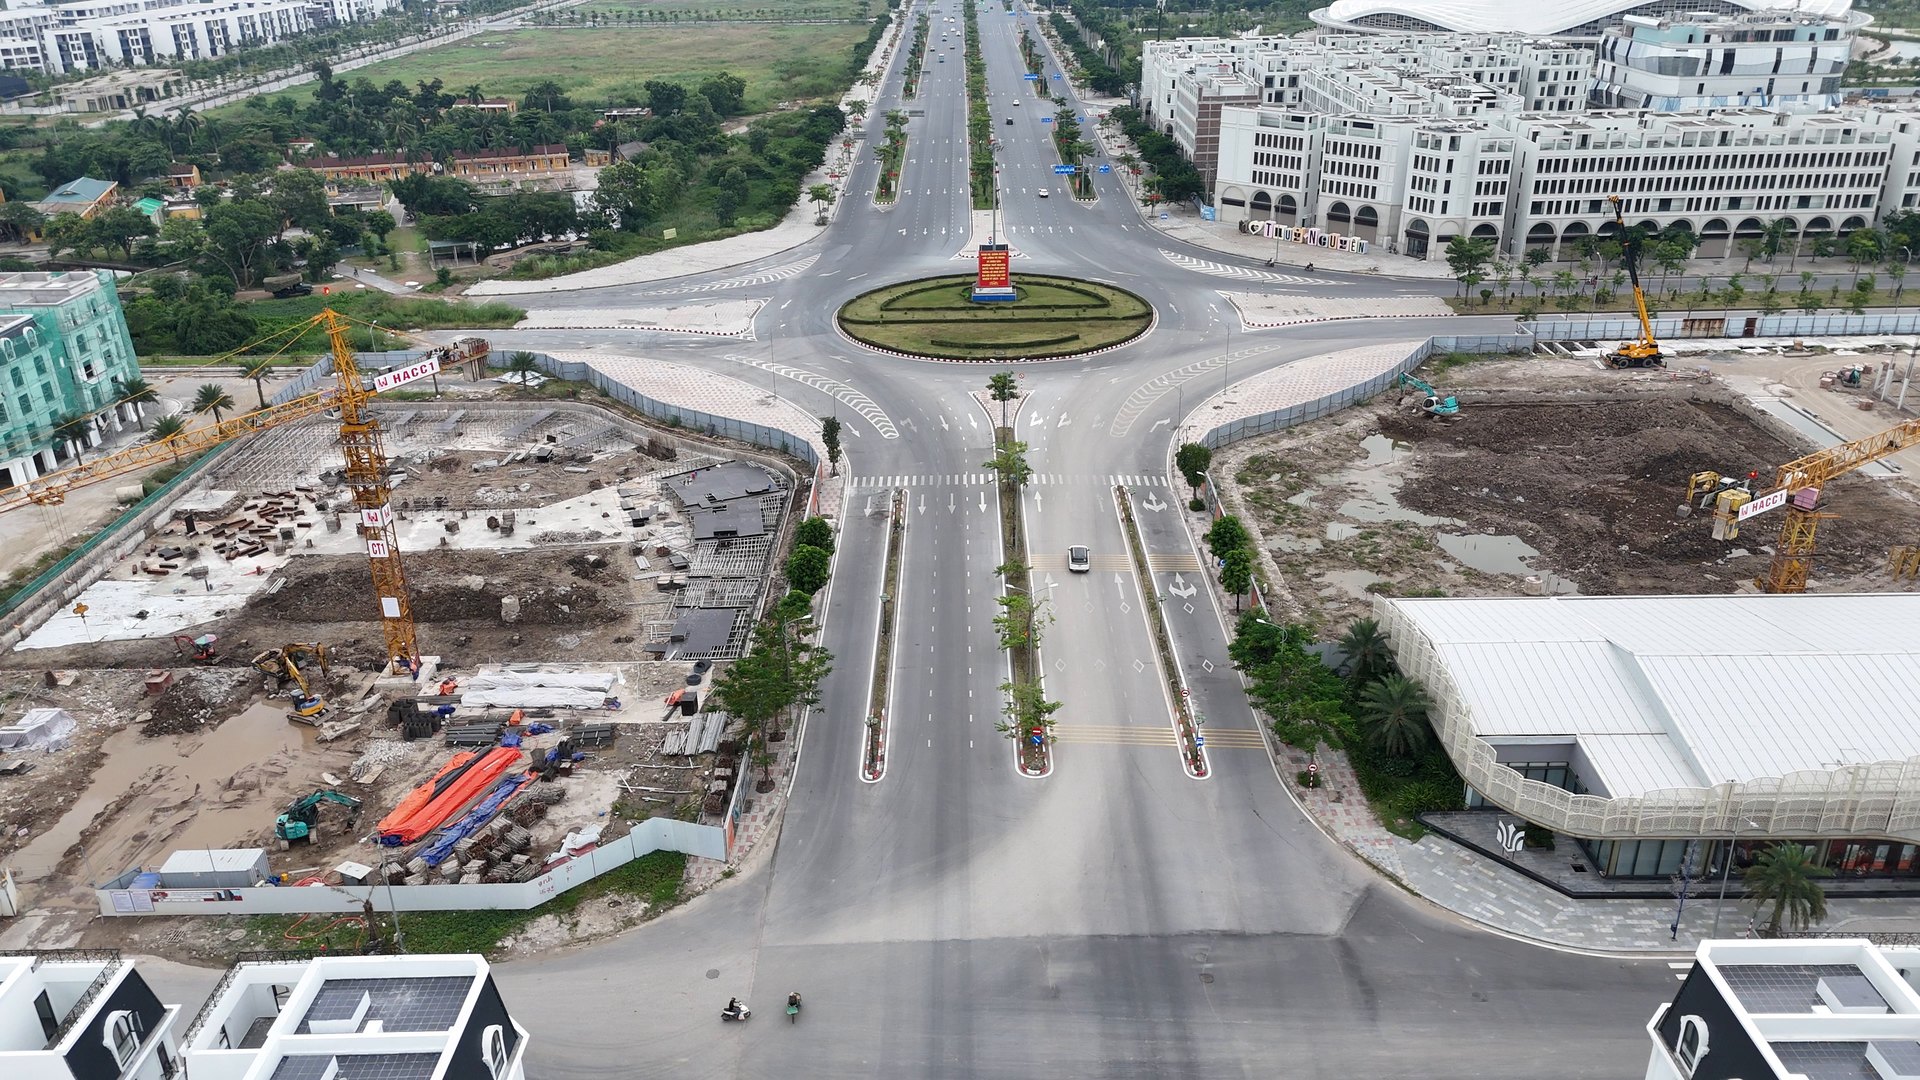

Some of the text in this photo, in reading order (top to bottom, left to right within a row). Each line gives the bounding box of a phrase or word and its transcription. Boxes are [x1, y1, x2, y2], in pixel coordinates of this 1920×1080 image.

[392, 361, 435, 384] HACC1
[1752, 493, 1783, 512] HACC1
[371, 542, 386, 555] CT1
